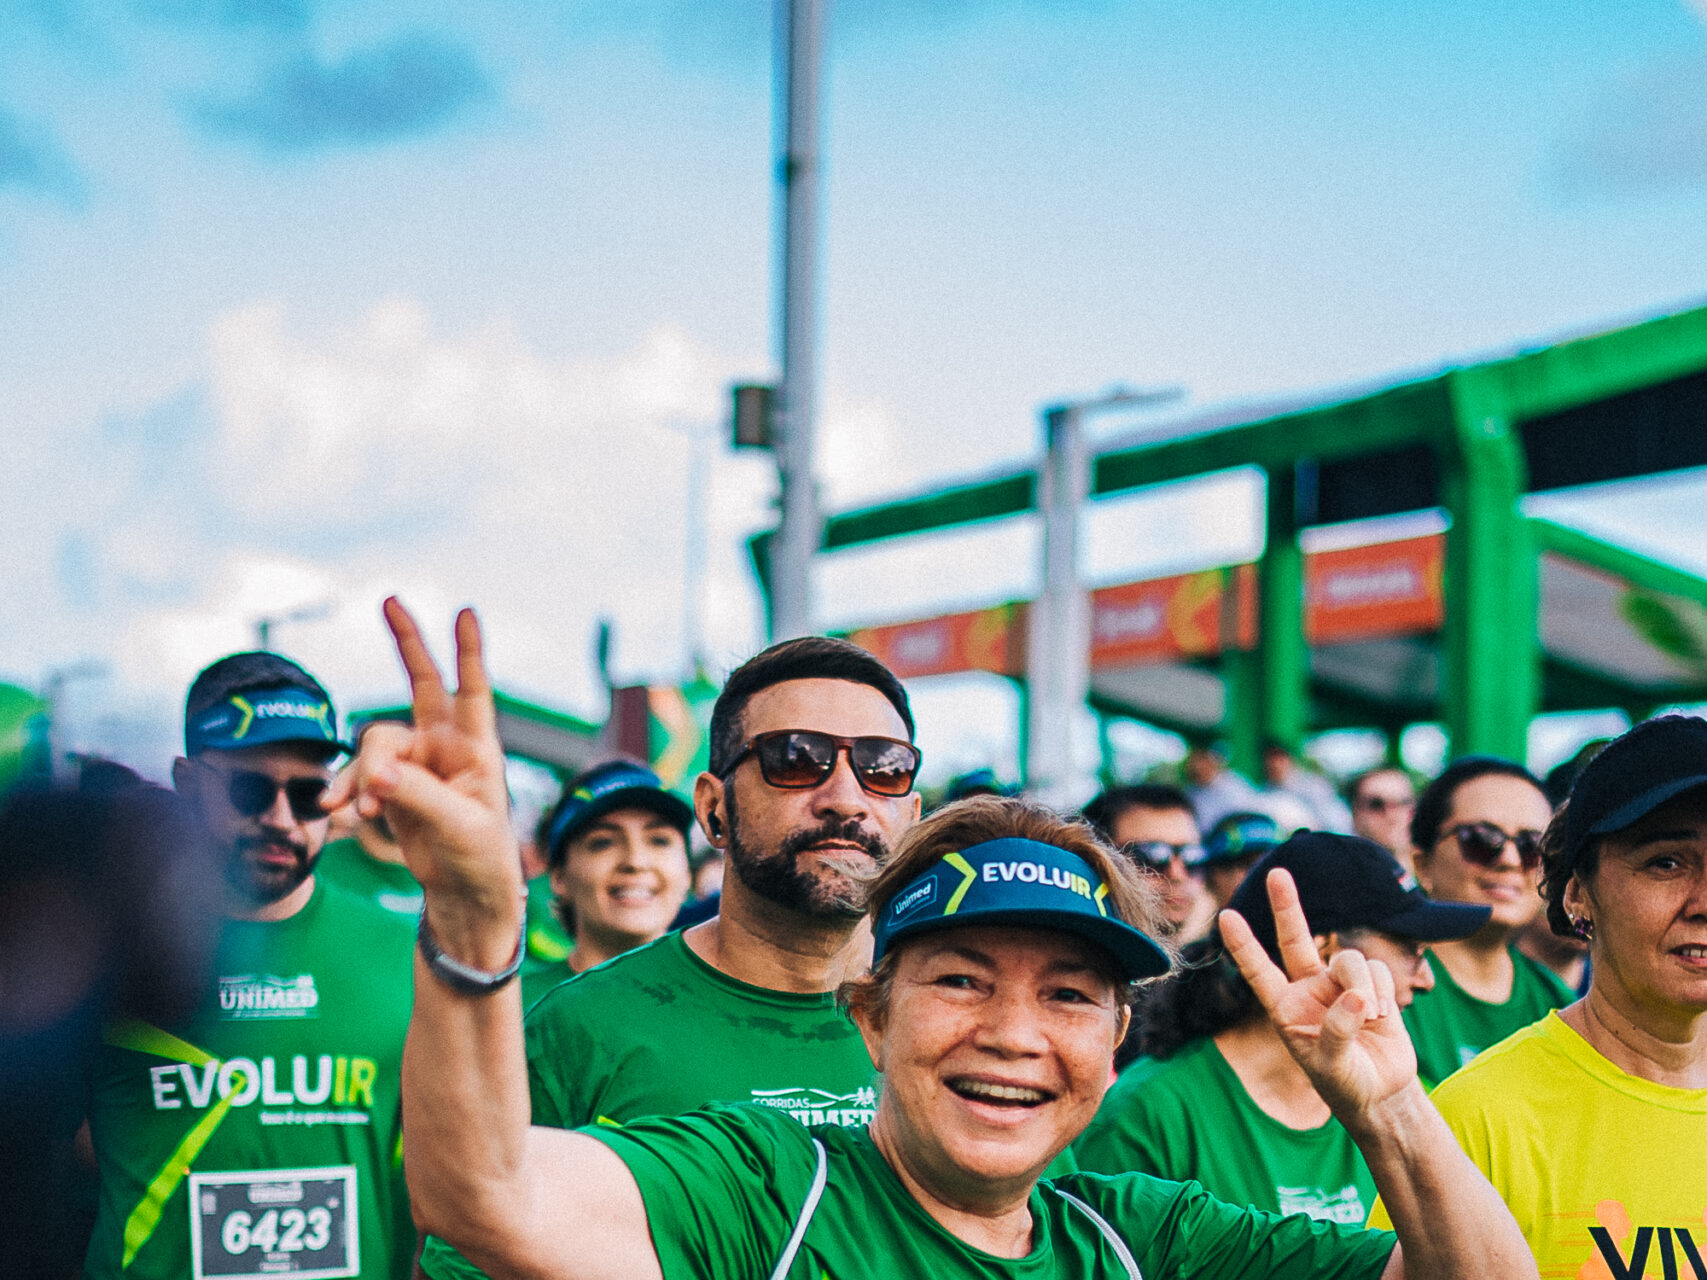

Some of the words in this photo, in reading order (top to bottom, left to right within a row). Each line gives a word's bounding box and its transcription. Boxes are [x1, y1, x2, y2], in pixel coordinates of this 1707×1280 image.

[895, 882, 931, 915] Unimed
[982, 861, 1092, 900] EVOLUIR
[219, 989, 318, 1009] UNIMED
[150, 1055, 376, 1110] EVOLUIR
[221, 1206, 332, 1255] 6423
